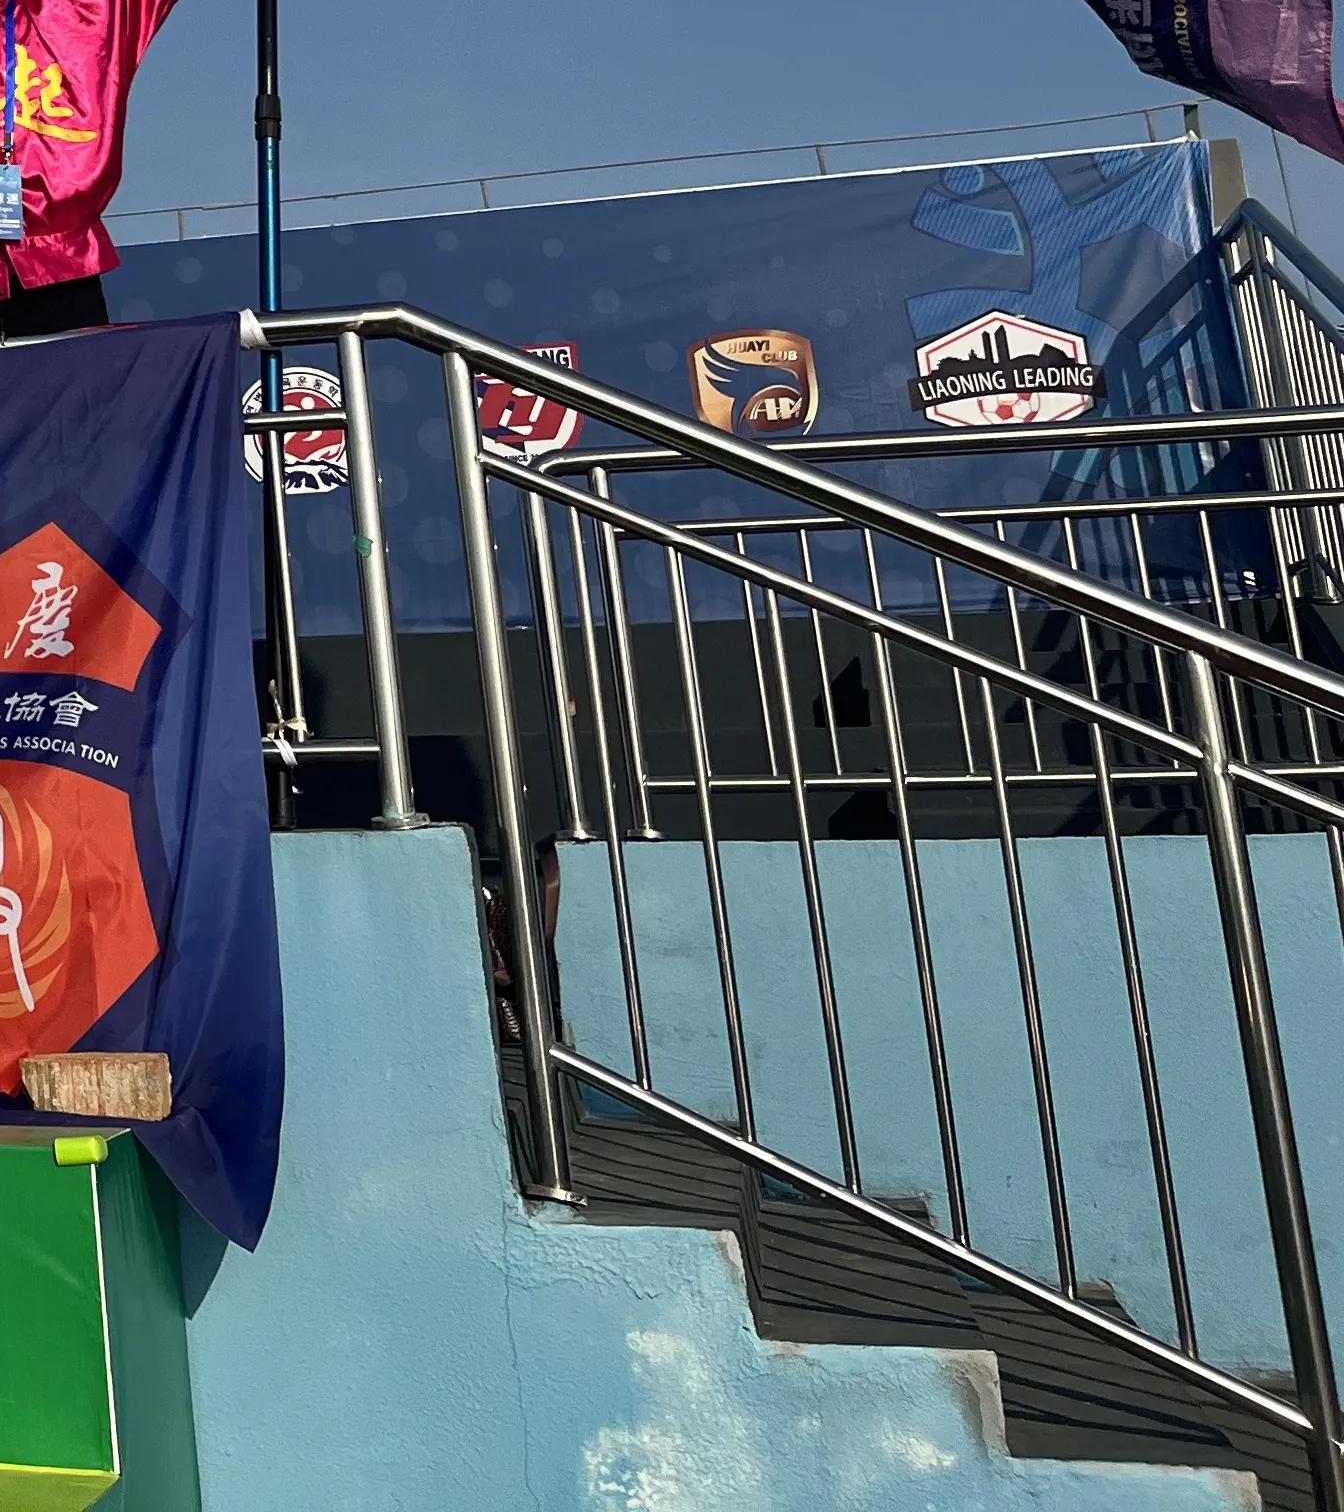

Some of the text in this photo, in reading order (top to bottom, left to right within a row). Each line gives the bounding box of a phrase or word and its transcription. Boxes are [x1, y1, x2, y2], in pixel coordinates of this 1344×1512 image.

[727, 340, 770, 354] HUAYI
[761, 350, 798, 363] CLUB
[918, 367, 1093, 401] LIAONING LEADING
